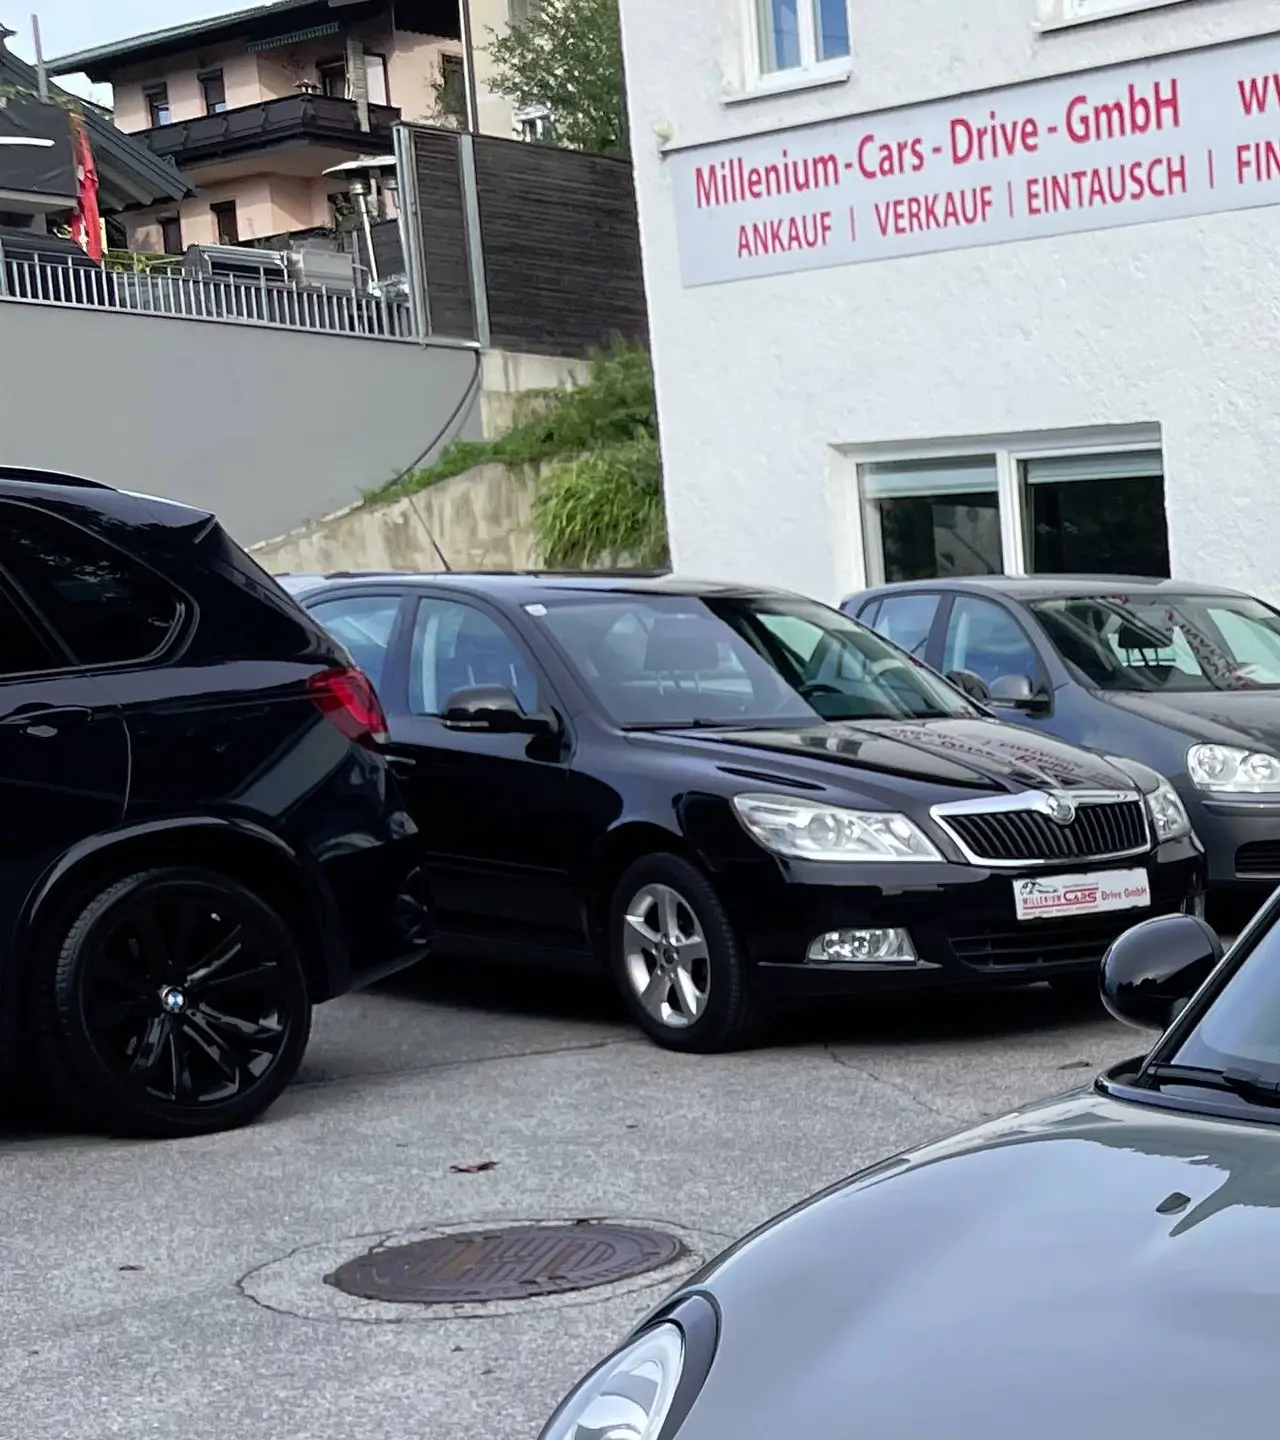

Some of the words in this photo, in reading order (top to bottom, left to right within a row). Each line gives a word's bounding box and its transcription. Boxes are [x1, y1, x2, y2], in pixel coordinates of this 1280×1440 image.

[738, 211, 832, 258] ANKAUF
[875, 186, 994, 237] VERKAUF
[1027, 156, 1188, 216] EINTAUSCH
[1101, 891, 1122, 901] Drive
[1124, 887, 1147, 898] GmbH
